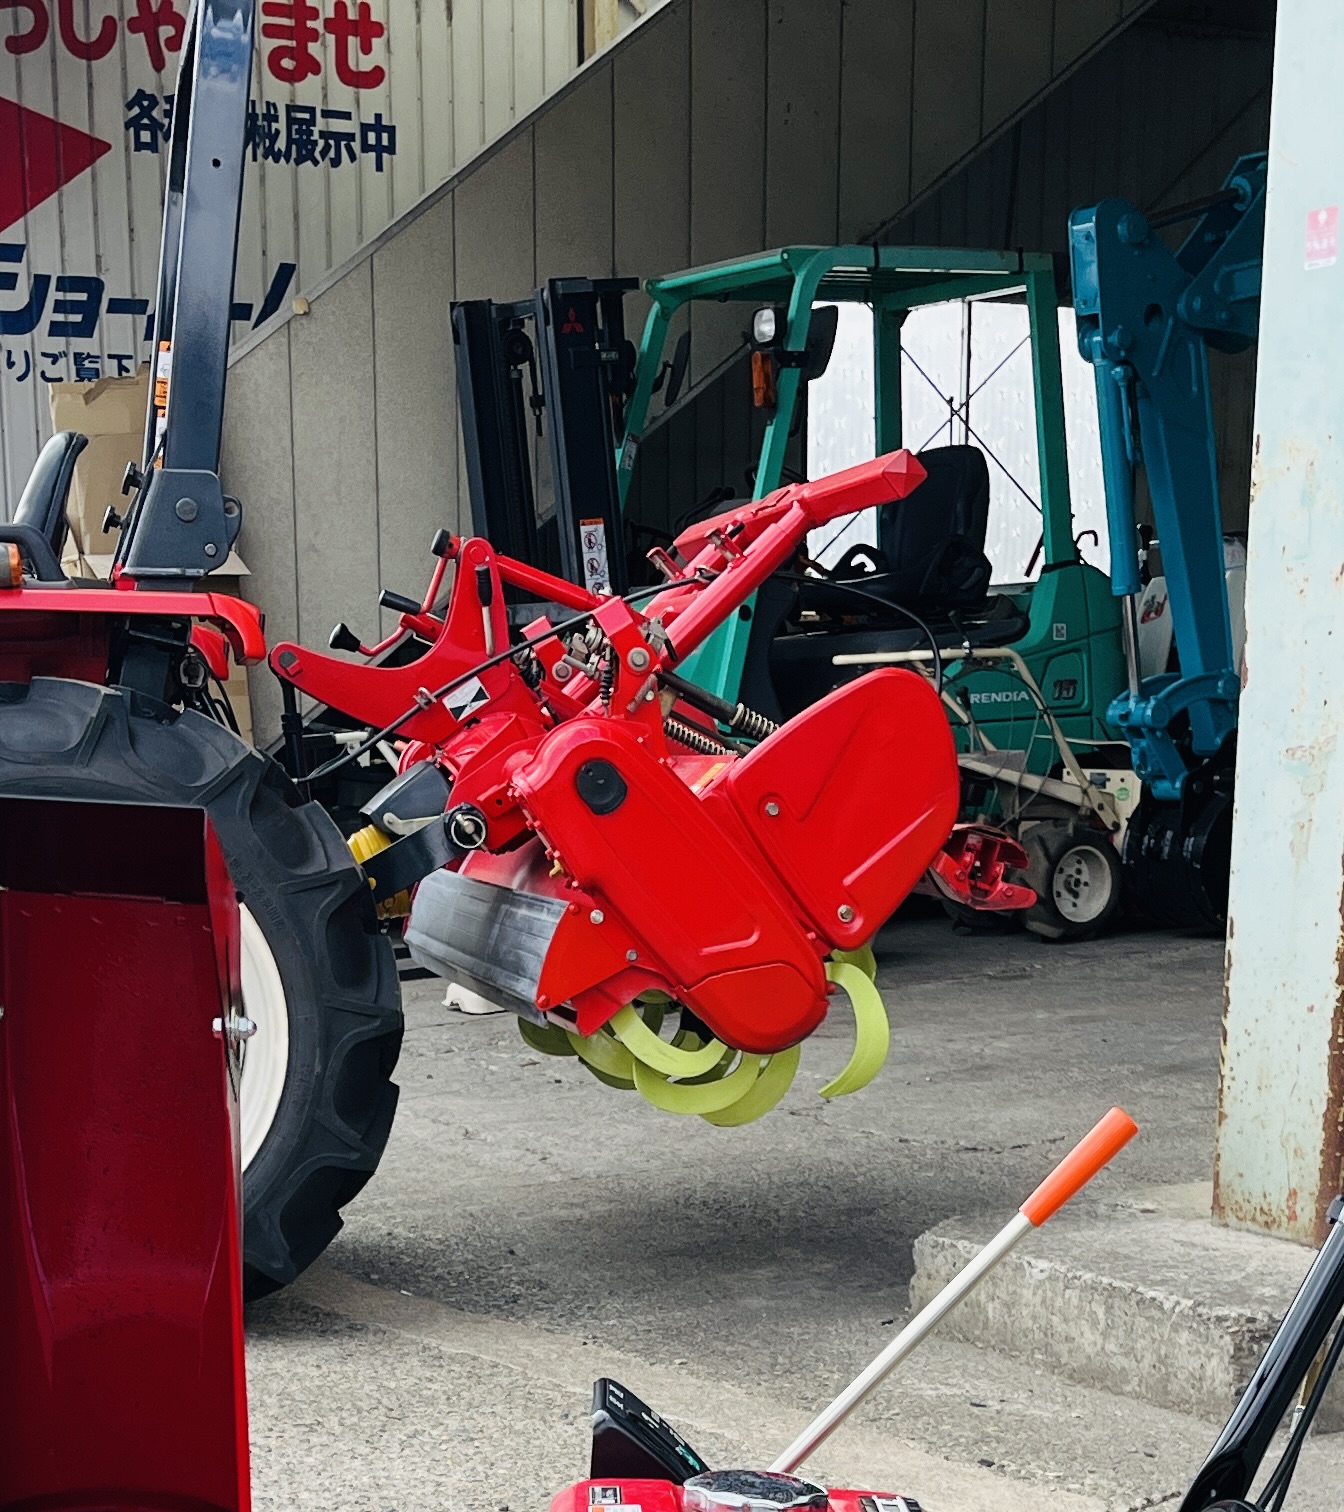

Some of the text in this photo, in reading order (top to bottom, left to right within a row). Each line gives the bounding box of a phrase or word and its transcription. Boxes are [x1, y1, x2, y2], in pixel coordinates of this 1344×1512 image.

[124, 88, 396, 172] 各械展示中
[956, 690, 1030, 705] RENDIA
